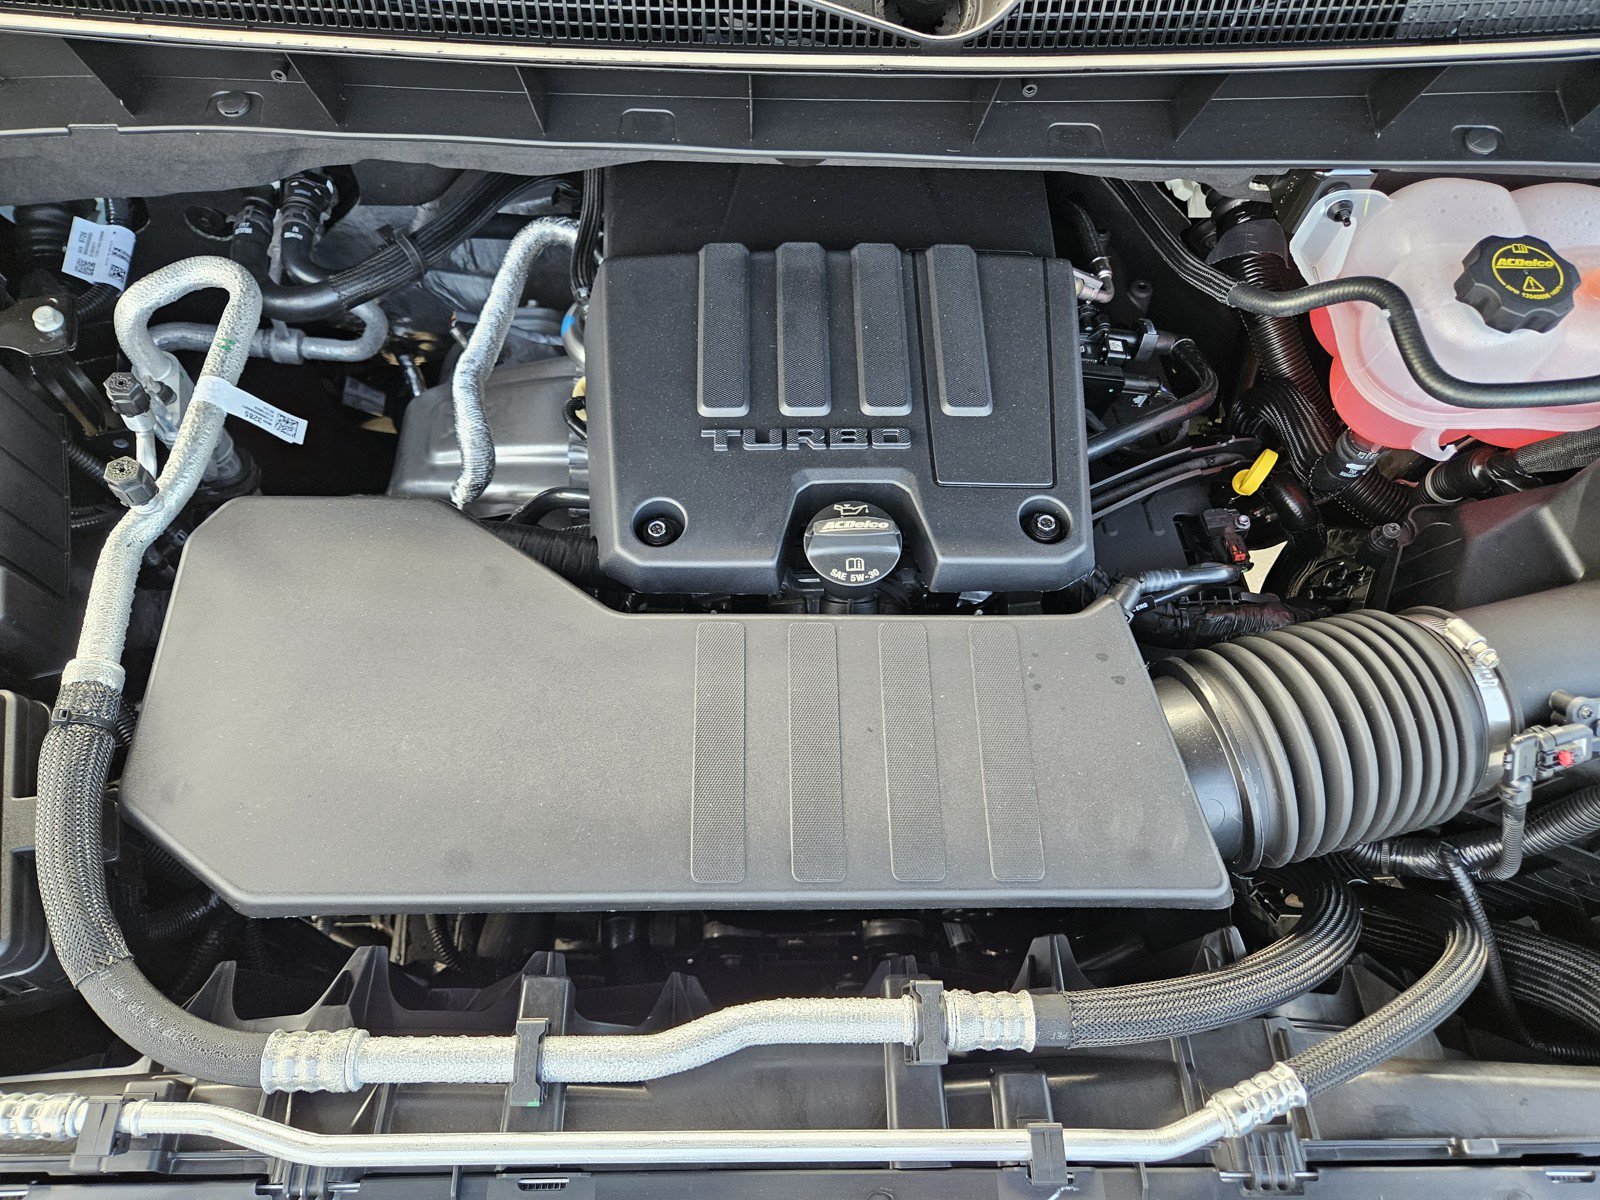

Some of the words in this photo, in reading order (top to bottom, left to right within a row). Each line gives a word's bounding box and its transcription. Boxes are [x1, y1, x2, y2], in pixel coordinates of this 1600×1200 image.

[1495, 257, 1554, 269] ACDelco
[701, 428, 911, 451] TURBO
[821, 520, 889, 532] ACDelco
[830, 569, 847, 581] SAE
[850, 569, 880, 582] 5W-30
